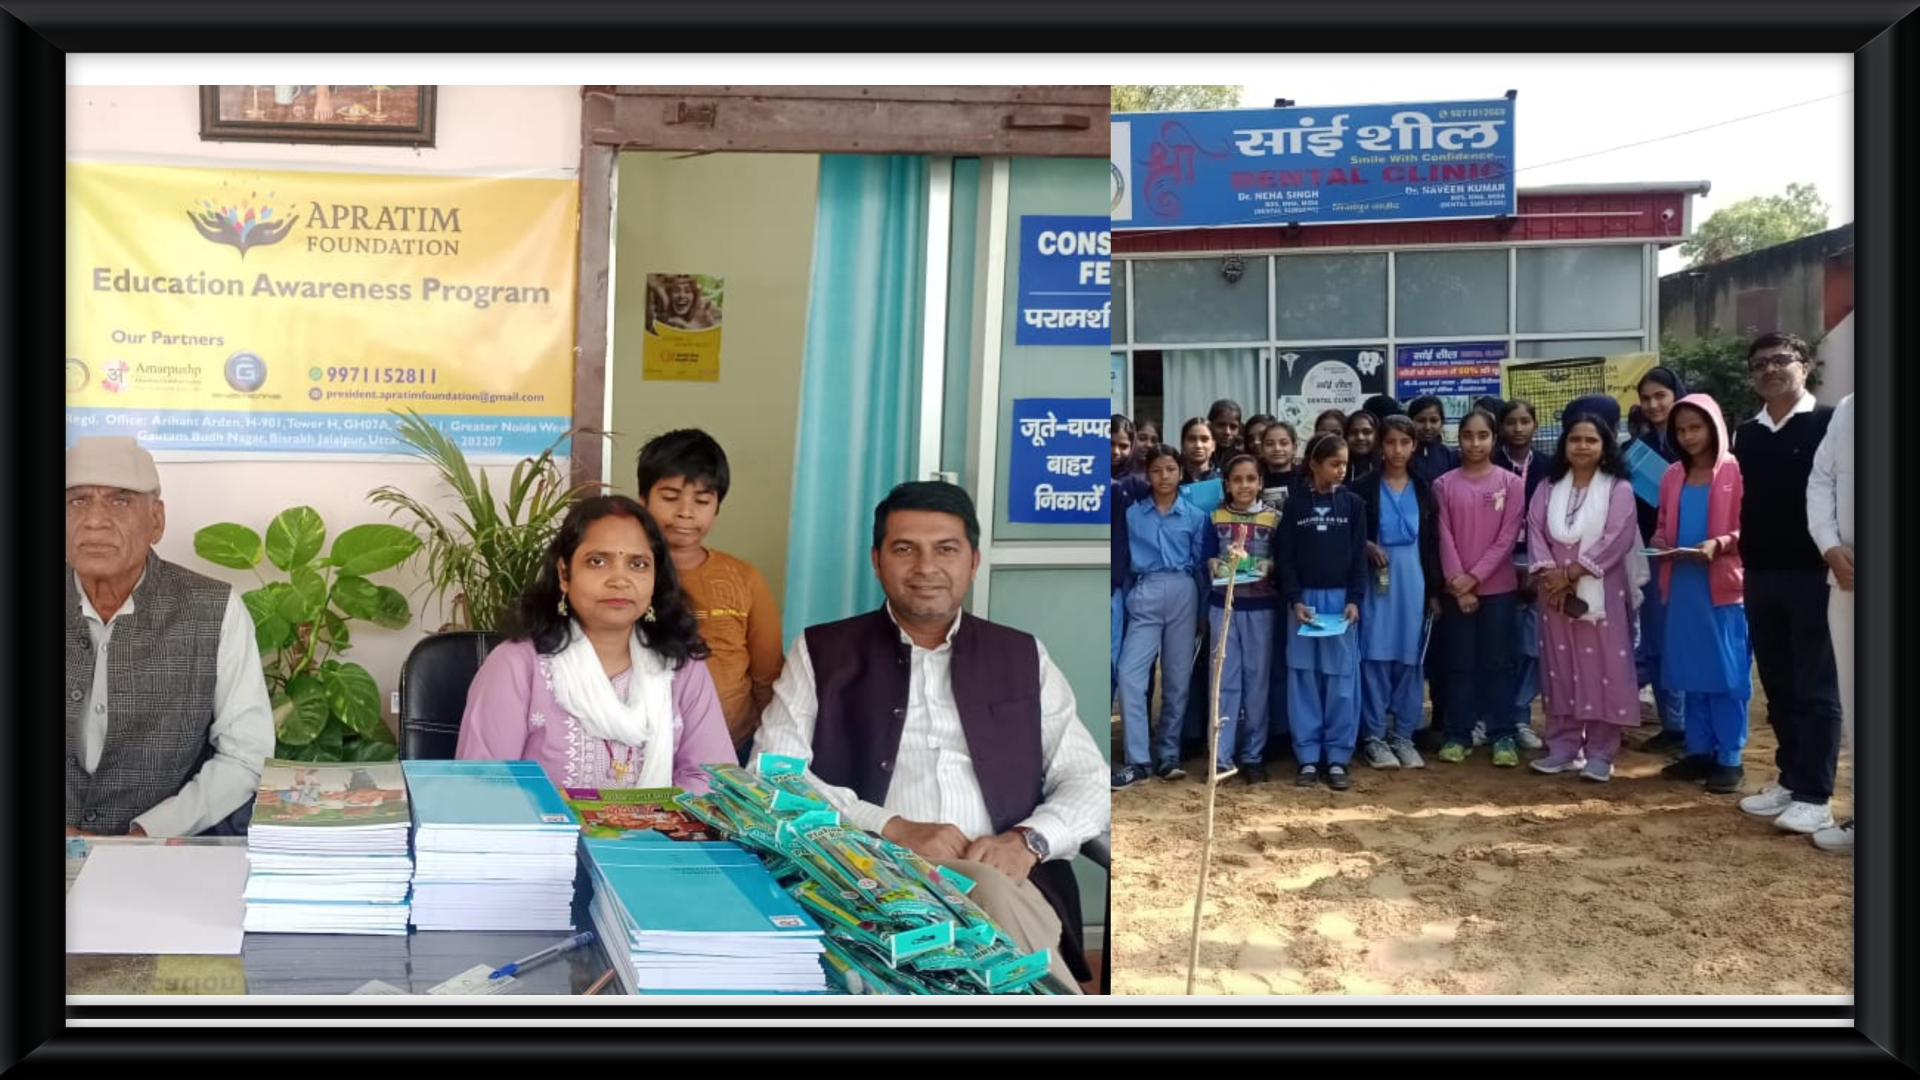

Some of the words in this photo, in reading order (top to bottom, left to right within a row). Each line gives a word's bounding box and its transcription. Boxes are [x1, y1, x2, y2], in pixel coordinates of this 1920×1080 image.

[1233, 113, 1350, 158] सांई
[1356, 111, 1506, 151] शील
[1350, 154, 1386, 165] Smile
[1390, 153, 1418, 163] With
[1231, 167, 1369, 190] DENTAL
[1382, 162, 1507, 183] CLINIC
[1237, 193, 1252, 201] Dr.
[1255, 191, 1284, 200] NEHA
[1286, 189, 1319, 199] SINGH
[1422, 184, 1465, 195] NAVEEN
[1467, 183, 1506, 193] KUMAR
[304, 200, 463, 234] APRATIM
[306, 235, 461, 257] FOUNDATION
[92, 266, 245, 297] Education
[250, 272, 412, 301] Awareness
[422, 276, 550, 310] Program
[110, 328, 147, 345] Our
[151, 330, 225, 347] Partners
[135, 362, 202, 378] Amarpushp
[326, 366, 437, 384] 9971152811
[325, 388, 545, 404] president.apratimfoundation@gmail.com
[1333, 396, 1356, 404] CLINIC
[151, 414, 200, 427] Arihant
[288, 418, 324, 429] Tower
[450, 420, 498, 432] Greater
[501, 421, 537, 433] Noida
[137, 430, 190, 442] Gautam
[191, 431, 225, 442] Budh
[269, 433, 316, 445] Bisrakh
[1046, 454, 1095, 475] बाहर
[1034, 483, 1106, 512] निकालें
